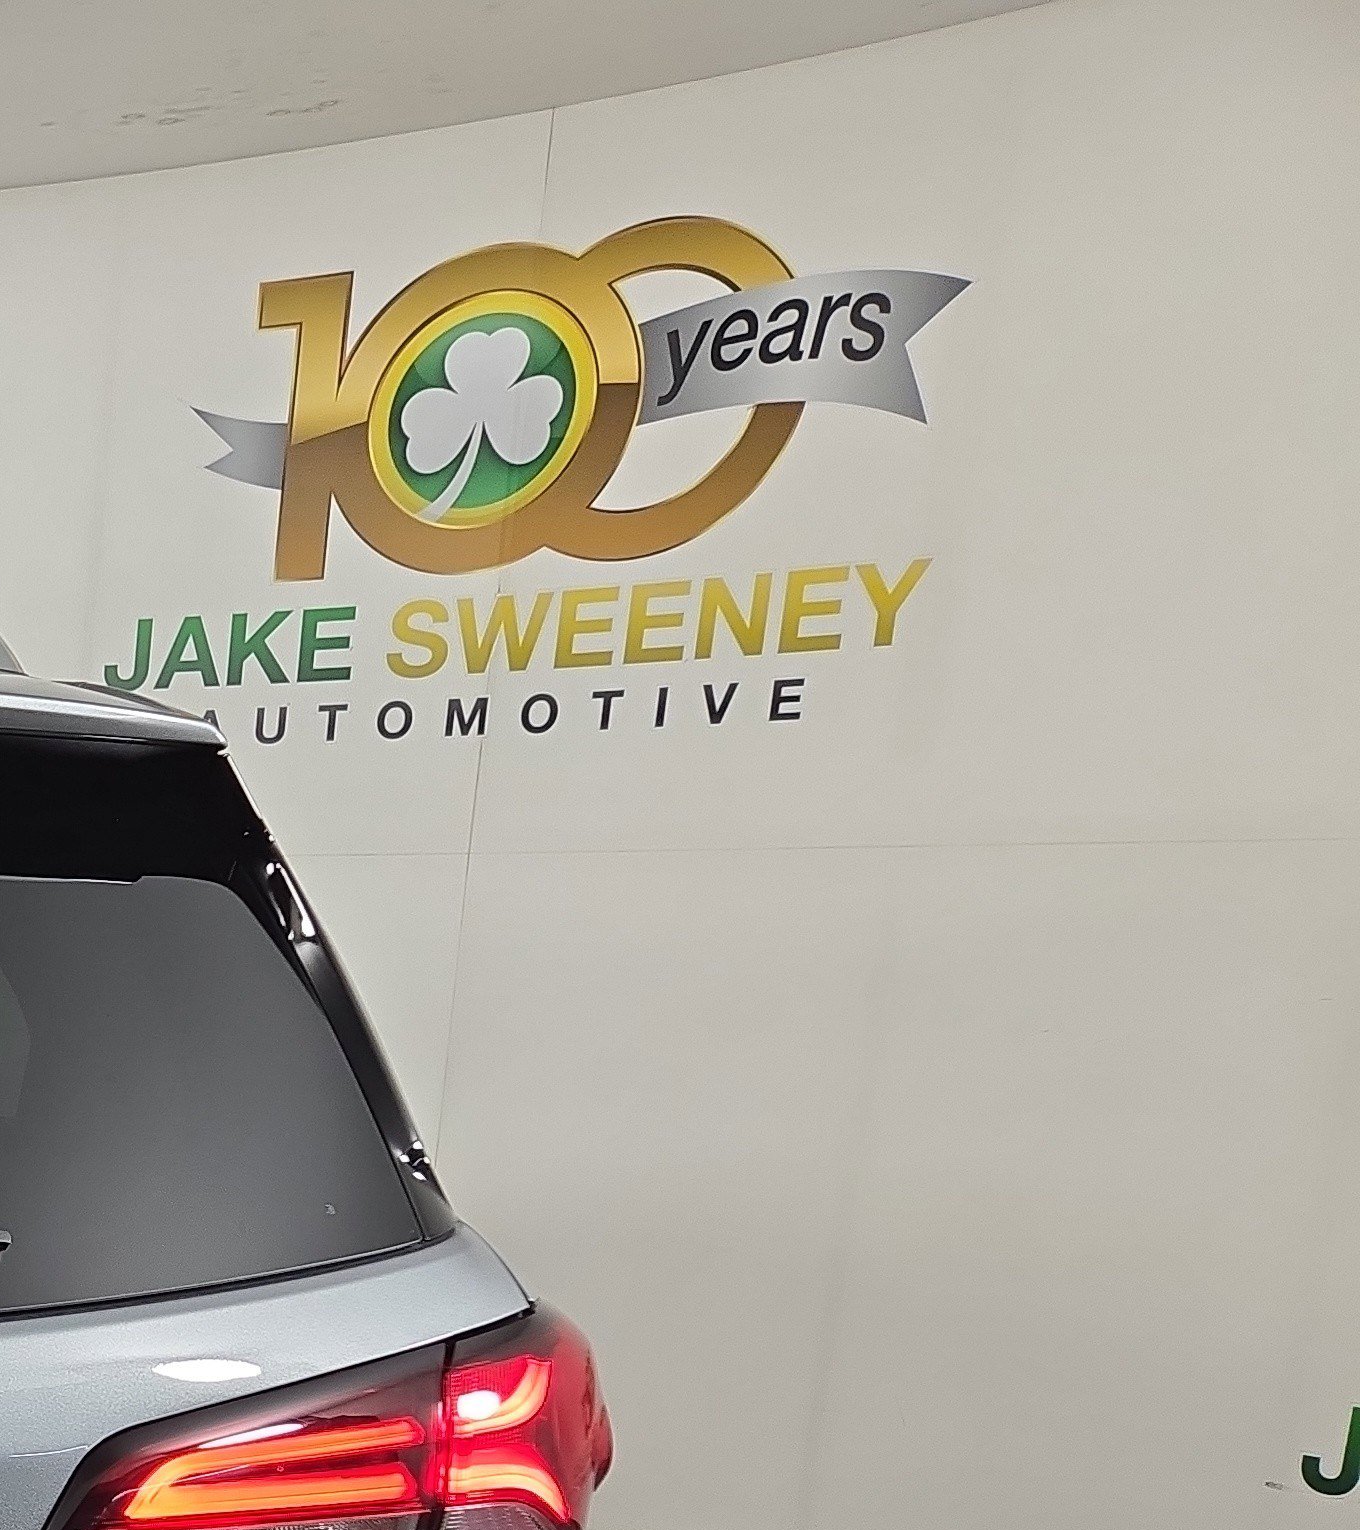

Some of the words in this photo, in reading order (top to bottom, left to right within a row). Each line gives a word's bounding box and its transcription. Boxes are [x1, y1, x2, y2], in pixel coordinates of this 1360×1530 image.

[657, 289, 892, 406] years
[103, 606, 358, 692] JAKE
[385, 557, 933, 679] SWEENEY
